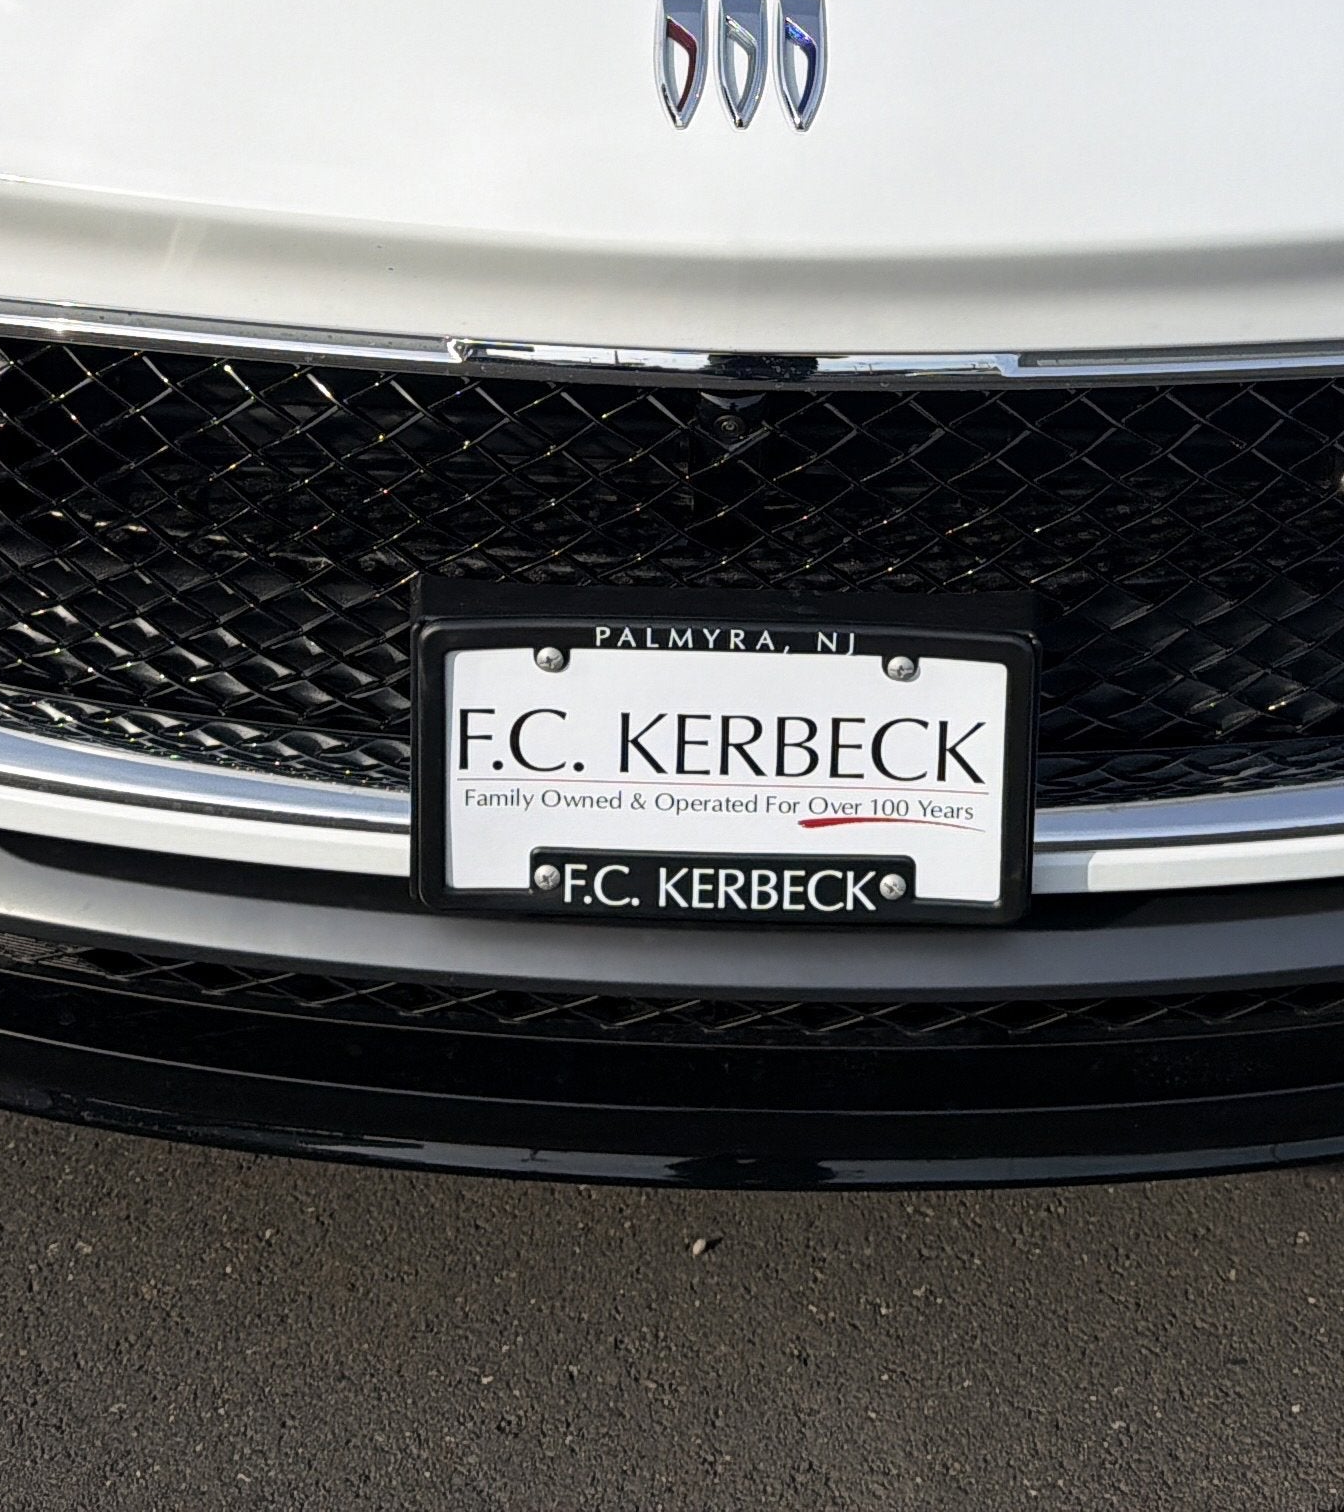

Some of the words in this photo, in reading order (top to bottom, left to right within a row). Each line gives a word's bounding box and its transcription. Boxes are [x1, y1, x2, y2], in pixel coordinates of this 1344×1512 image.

[595, 626, 790, 654] PALMYRA,
[816, 631, 855, 656] NJ
[457, 707, 585, 773] F.C.
[619, 711, 987, 785] KERBECK
[464, 789, 535, 811] Family
[541, 789, 622, 810] Owned
[630, 793, 647, 810] &
[654, 791, 758, 815] Operated
[766, 796, 800, 814] For
[809, 797, 862, 816] Over
[871, 799, 909, 816] 100
[918, 799, 975, 820] Years
[563, 863, 640, 906] F.C.
[658, 866, 877, 911] KERBECK
